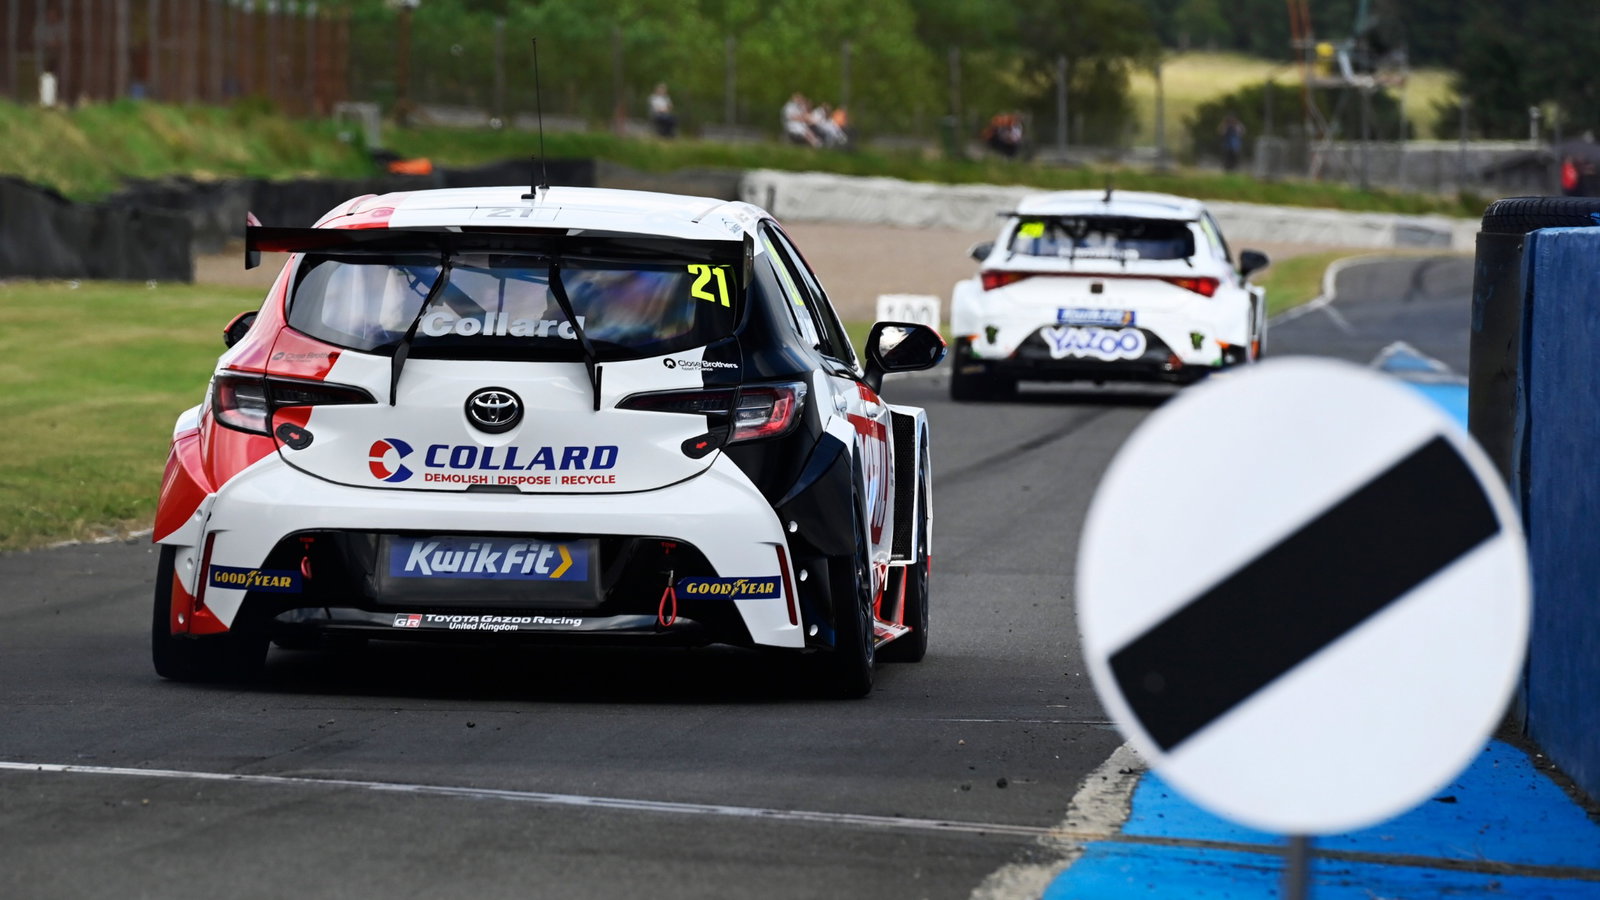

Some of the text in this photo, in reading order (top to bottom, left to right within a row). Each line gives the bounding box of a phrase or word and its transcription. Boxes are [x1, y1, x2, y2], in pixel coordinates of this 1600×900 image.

[687, 264, 731, 307] 21
[421, 311, 585, 340] Collard
[1046, 326, 1140, 354] YAZOO
[677, 359, 739, 369] Close Brothers
[424, 444, 619, 471] COLLARD
[424, 473, 616, 485] DEMOLISH DISPOSE RECYCLE
[394, 617, 421, 628] GR
[449, 622, 519, 633] United Kingdom
[532, 616, 583, 627] Racing
